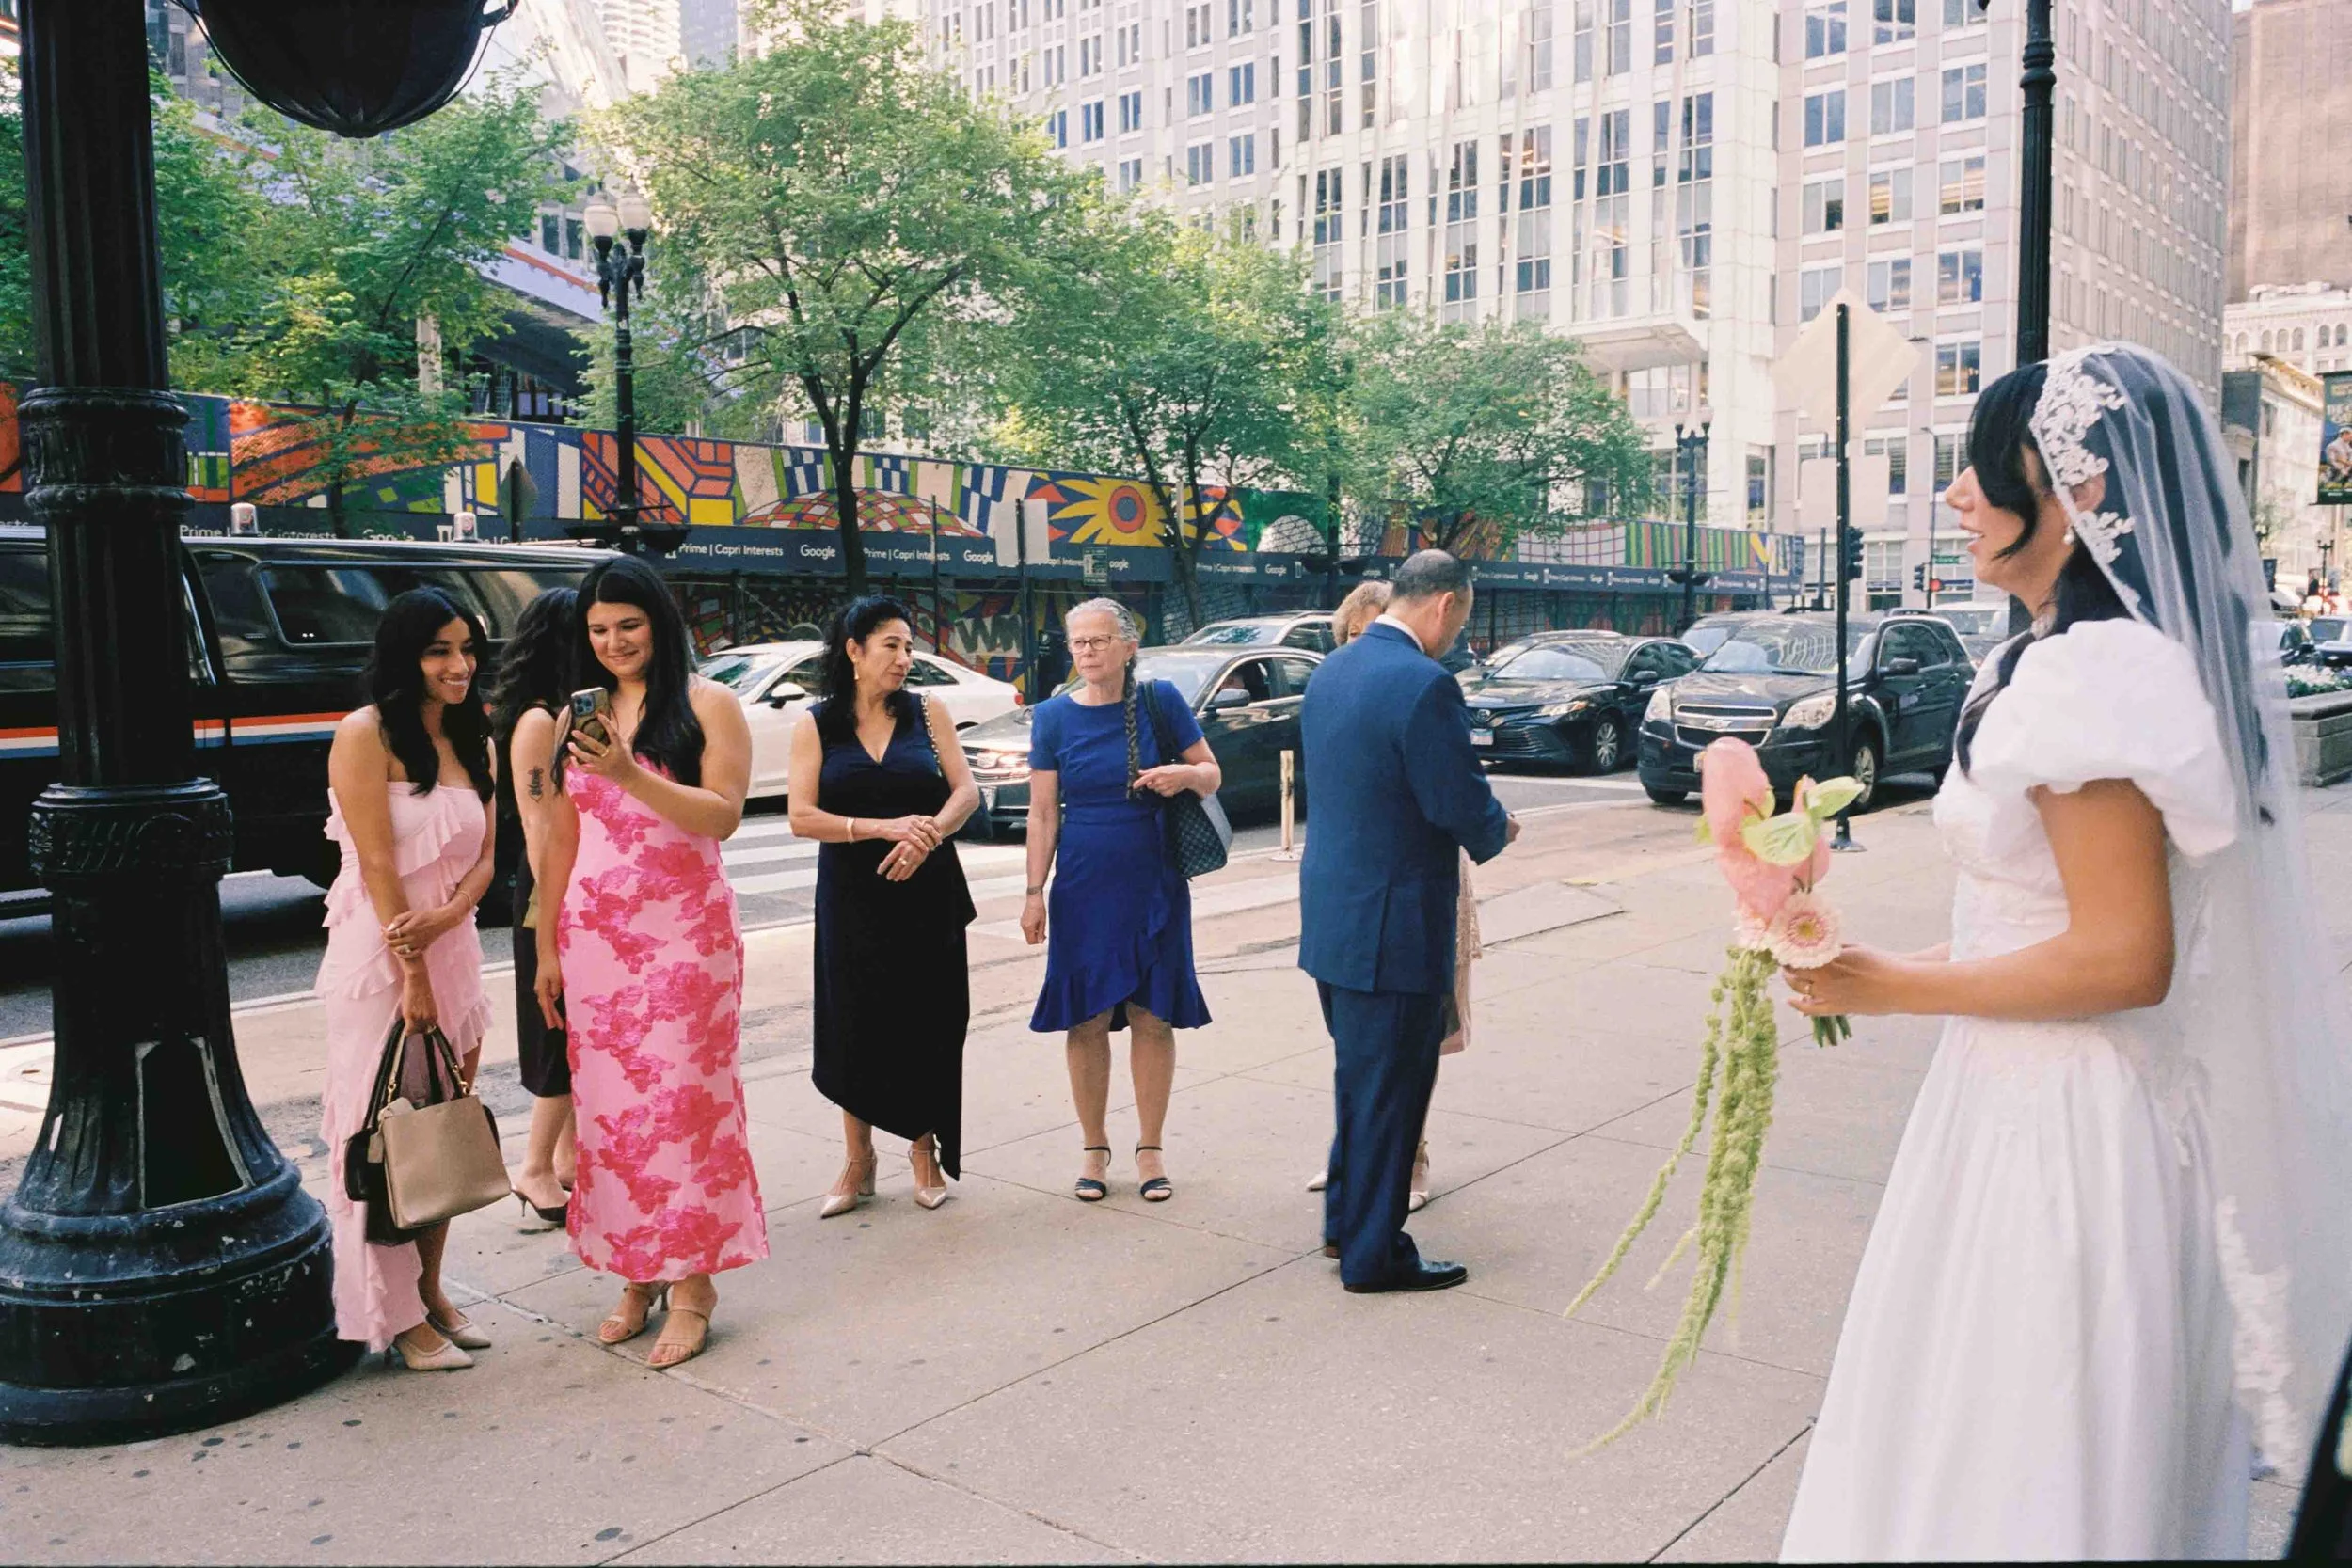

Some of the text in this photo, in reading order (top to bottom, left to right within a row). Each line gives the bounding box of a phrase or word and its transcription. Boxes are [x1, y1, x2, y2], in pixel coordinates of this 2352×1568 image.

[715, 543, 741, 556] Capri
[743, 545, 784, 557] Interests
[800, 544, 836, 561] Google
[893, 548, 914, 562] Capri
[963, 549, 994, 565] Google
[1109, 559, 1129, 572] oogle
